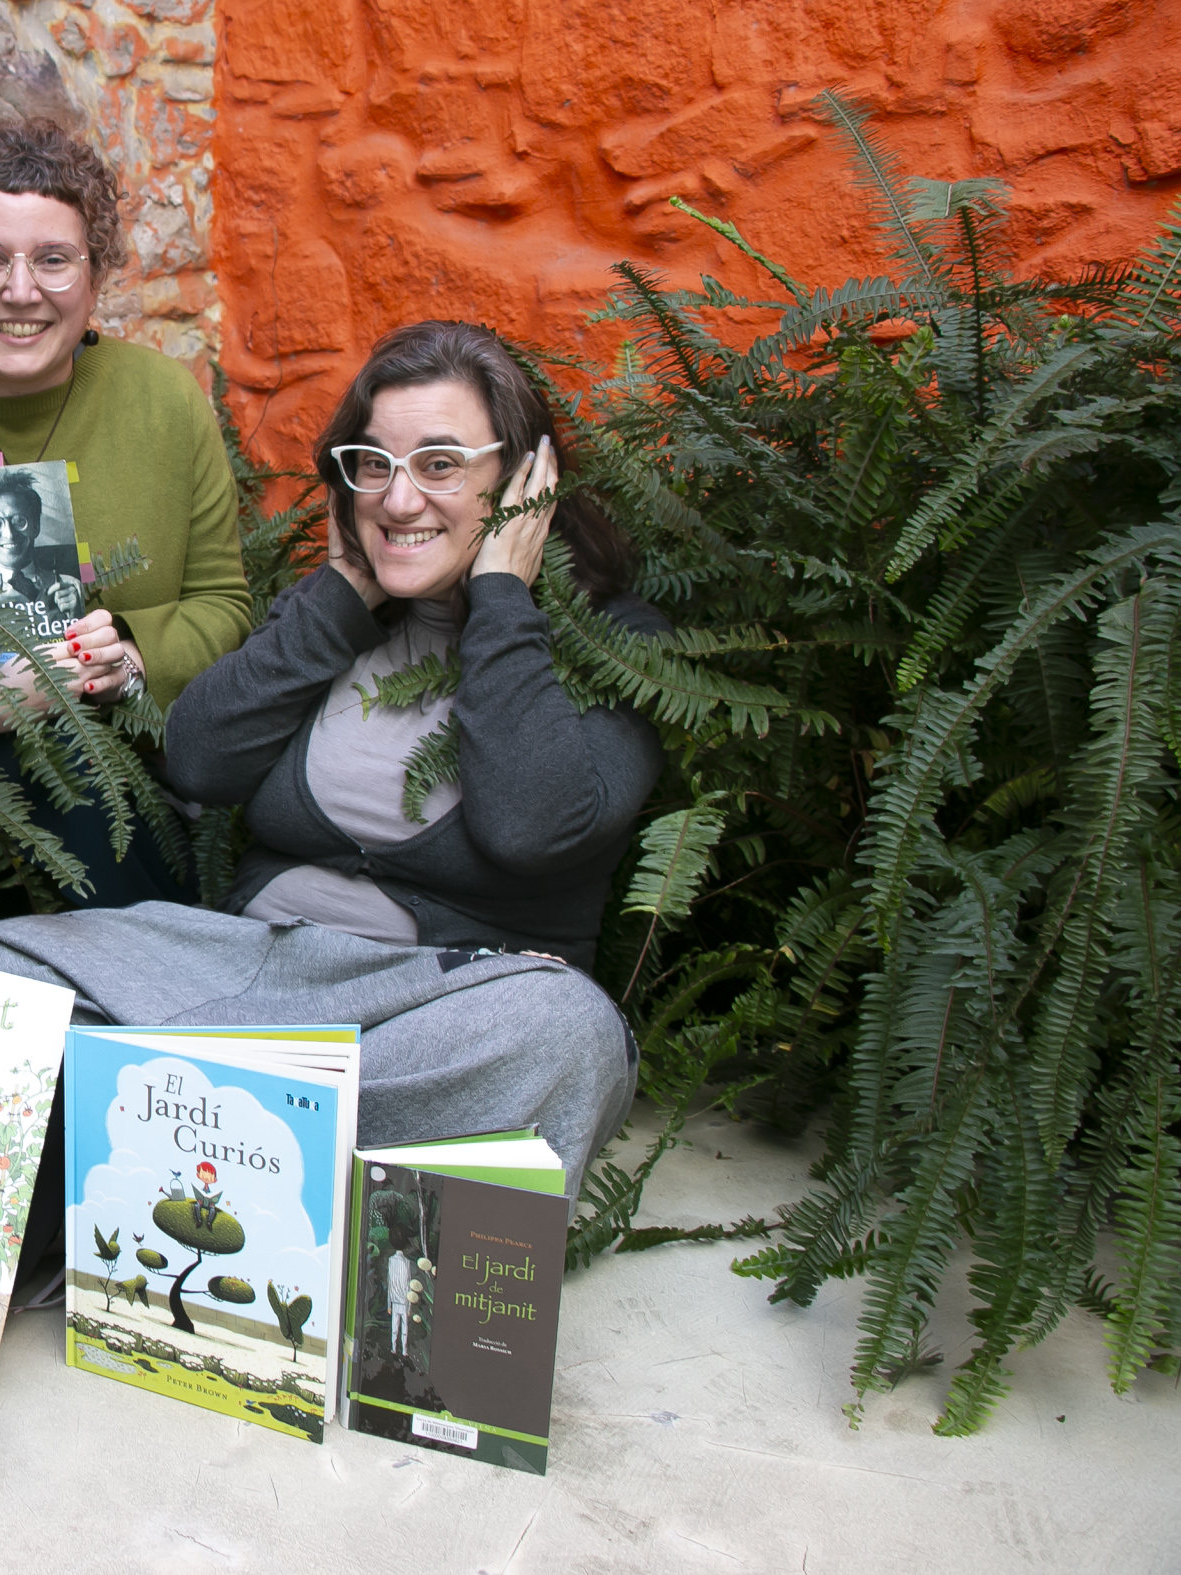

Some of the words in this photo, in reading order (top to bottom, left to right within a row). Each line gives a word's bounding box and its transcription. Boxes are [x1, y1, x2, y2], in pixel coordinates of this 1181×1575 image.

[164, 1073, 183, 1096] El
[137, 1084, 222, 1130] Jardí
[173, 1125, 281, 1174] Curiós
[462, 1253, 479, 1270] El
[476, 1256, 536, 1285] jardí
[489, 1281, 504, 1294] de
[455, 1292, 537, 1324] mitjanit
[166, 1375, 194, 1391] PETER
[196, 1383, 228, 1401] BROWN
